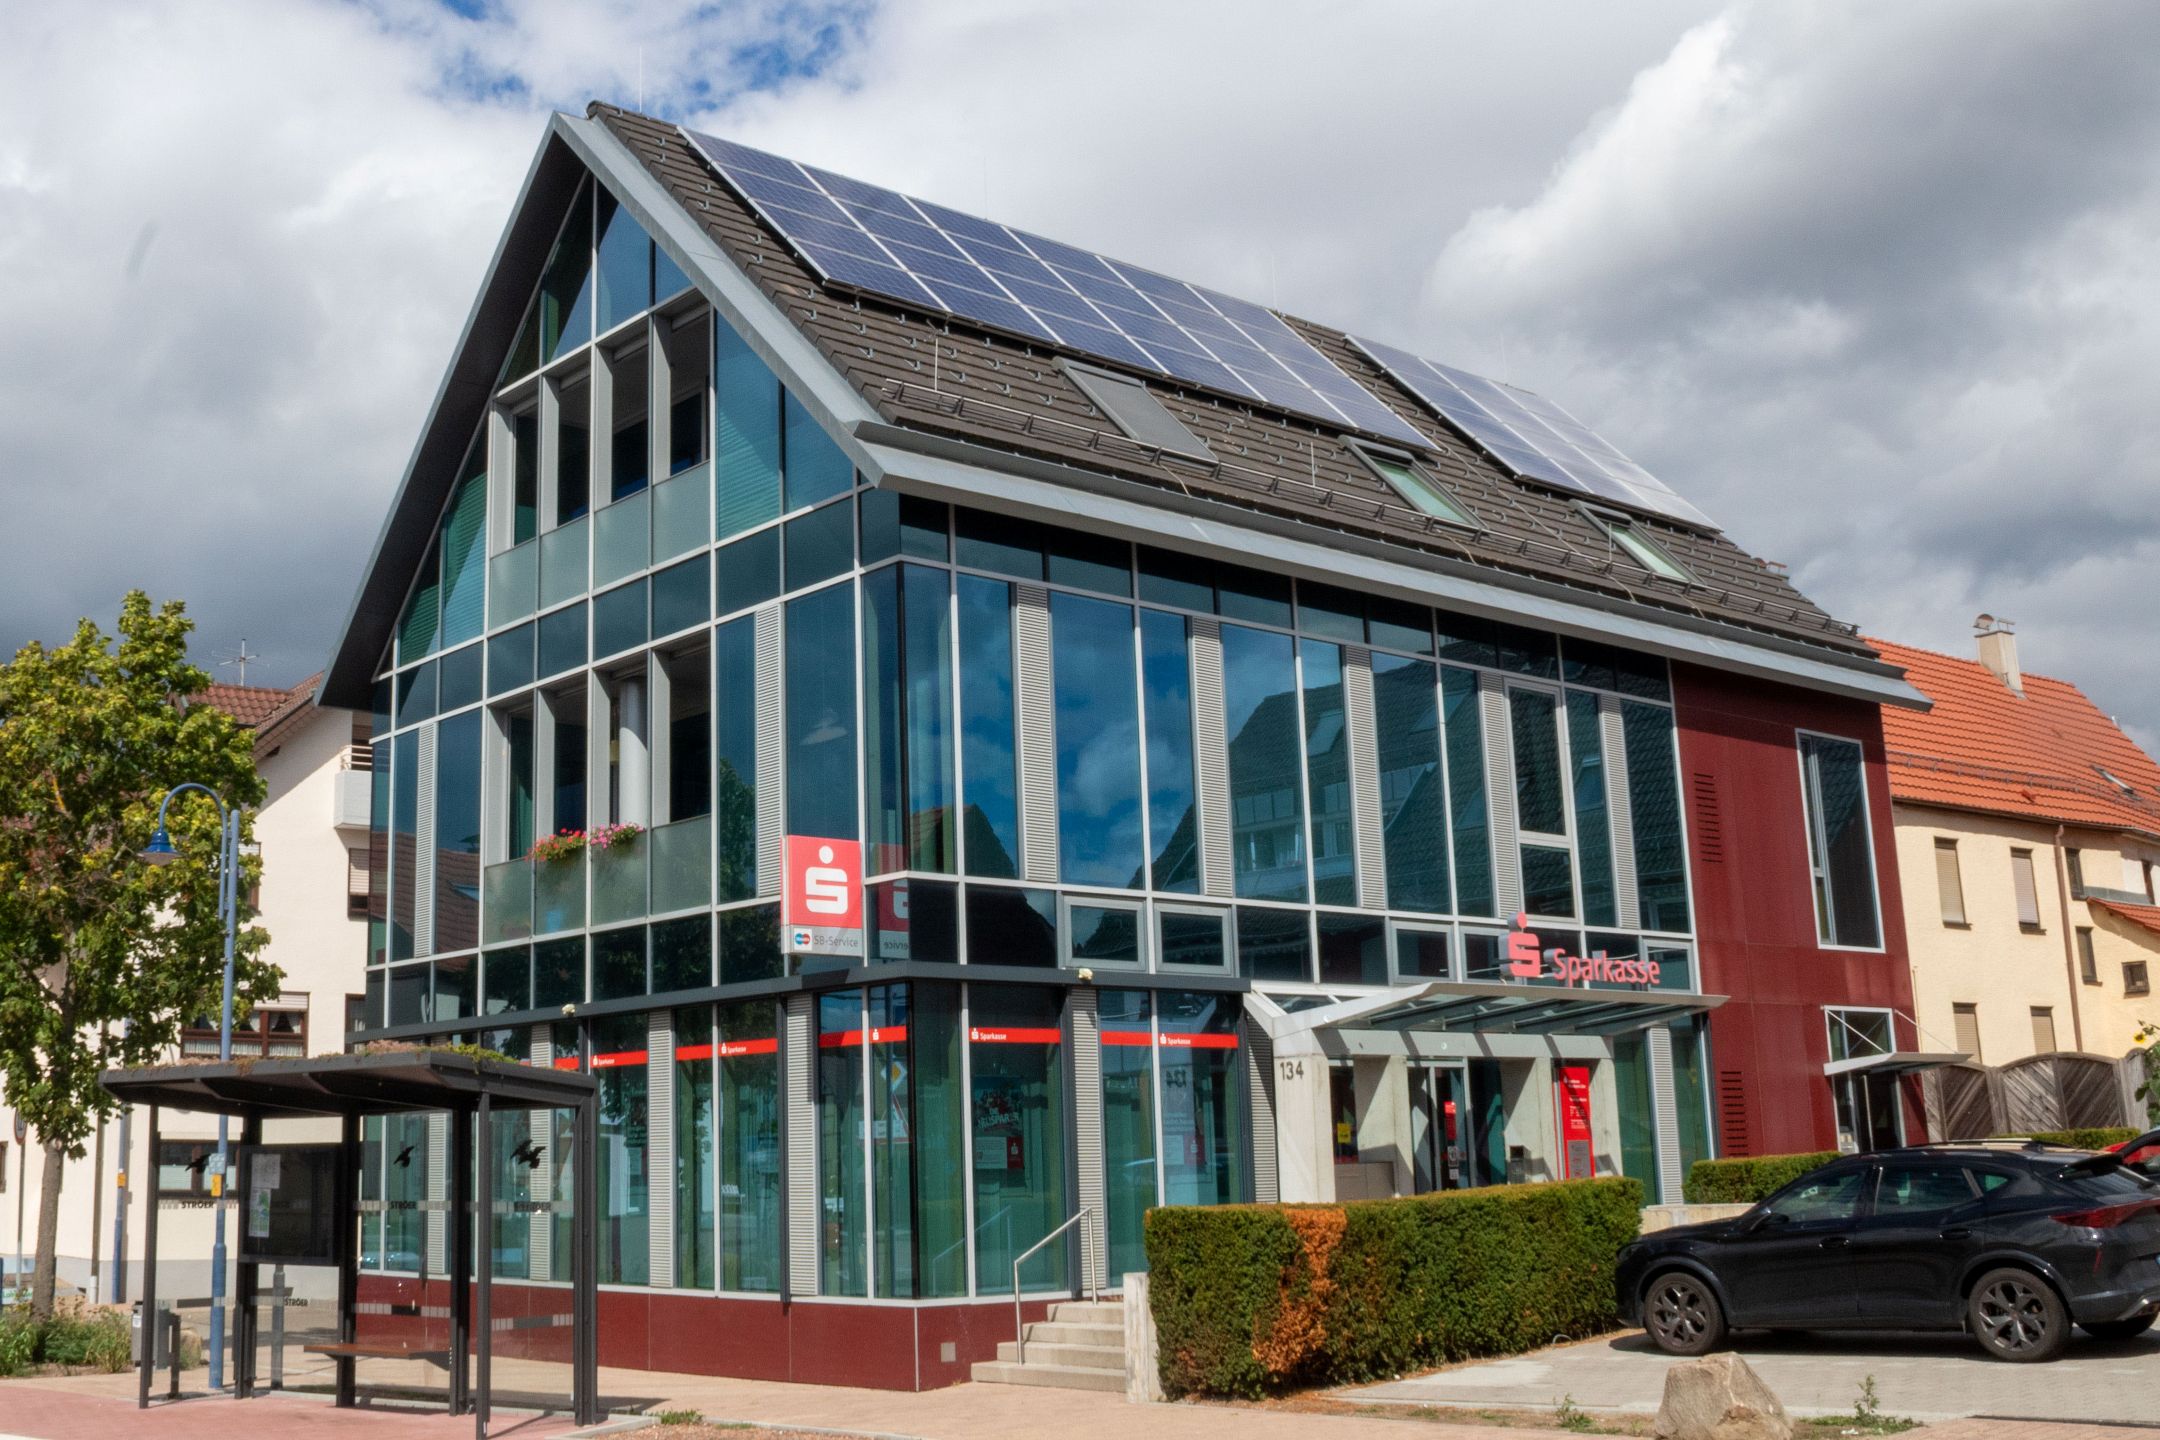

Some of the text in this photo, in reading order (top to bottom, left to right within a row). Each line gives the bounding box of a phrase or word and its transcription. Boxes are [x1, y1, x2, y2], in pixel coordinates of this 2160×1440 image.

[805, 845, 848, 914] S
[814, 936, 859, 948] SB-Service
[1553, 948, 1661, 988] Sparkasse
[980, 1032, 1007, 1041] Sparkasse
[1168, 1037, 1191, 1046] Sparkasse
[728, 1046, 747, 1054] Sparkasse
[1280, 1061, 1304, 1081] 134
